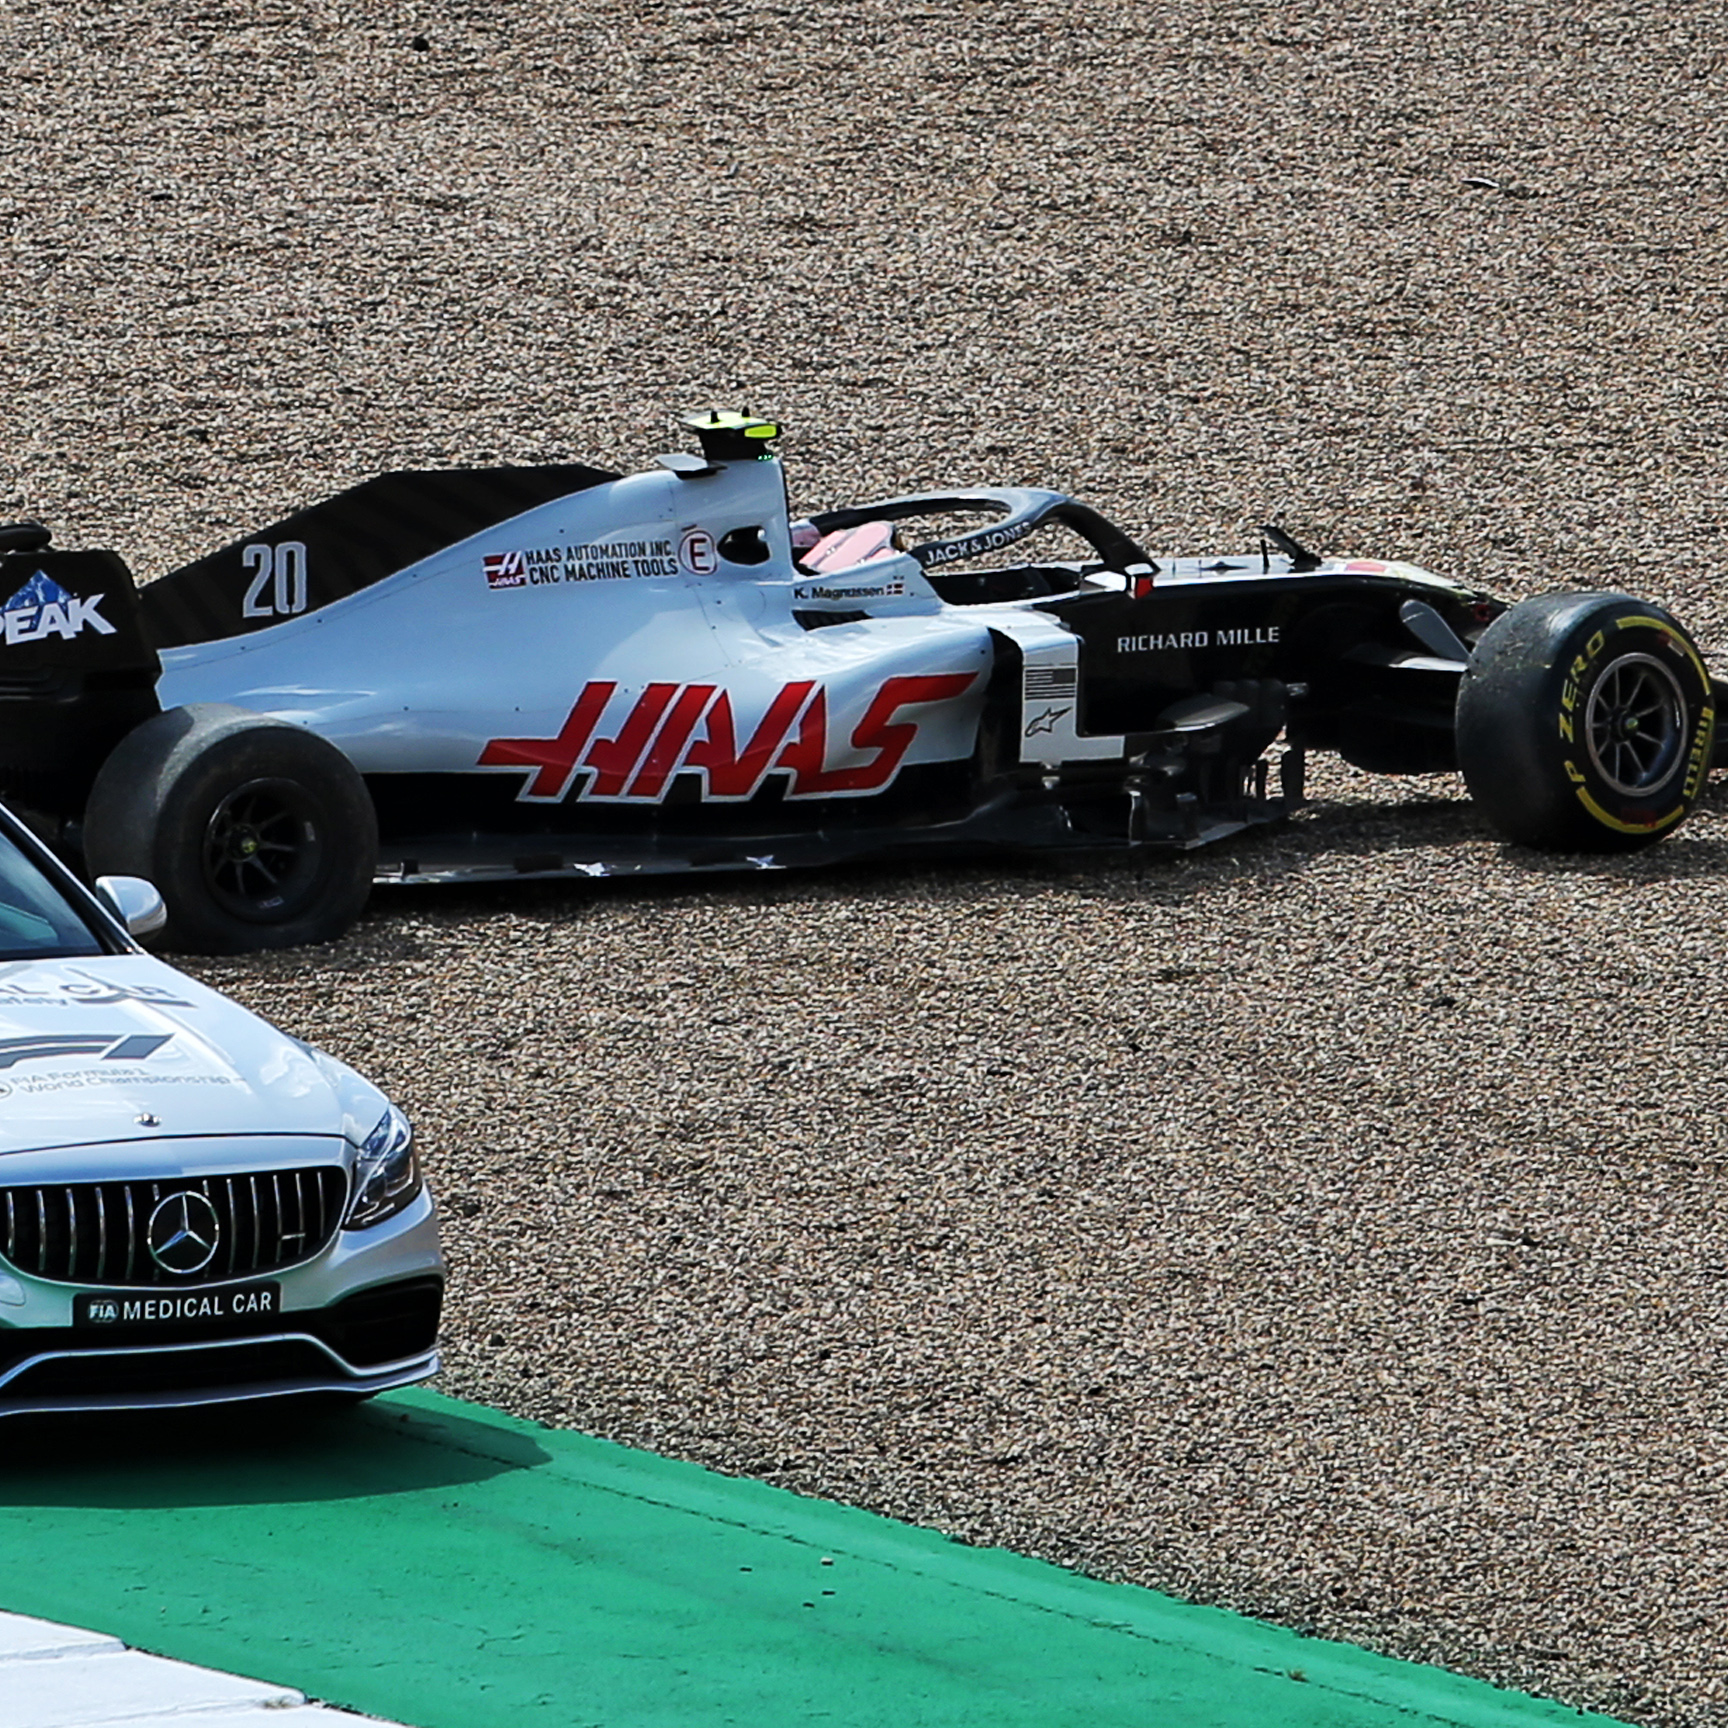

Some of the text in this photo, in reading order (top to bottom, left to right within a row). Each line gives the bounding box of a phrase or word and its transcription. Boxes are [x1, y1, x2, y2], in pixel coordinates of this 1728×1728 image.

[525, 540, 676, 565] HAAS AUTOMATION INC.
[689, 537, 711, 572] E
[925, 522, 1033, 566] JACK & JONES
[242, 541, 307, 618] 20
[529, 558, 679, 586] CNC MACHINE TOOLS
[794, 586, 885, 600] K. Magnussen
[1117, 626, 1280, 653] RICHARD MILLE
[1559, 630, 1605, 783] P ZERO
[476, 671, 981, 804] HAAS
[1683, 706, 1714, 799] PIRELLI
[58, 982, 178, 999] CAR
[19, 1080, 84, 1093] World
[48, 1069, 132, 1081] Formula
[89, 1291, 272, 1320] FIA MEDICAL CAR
